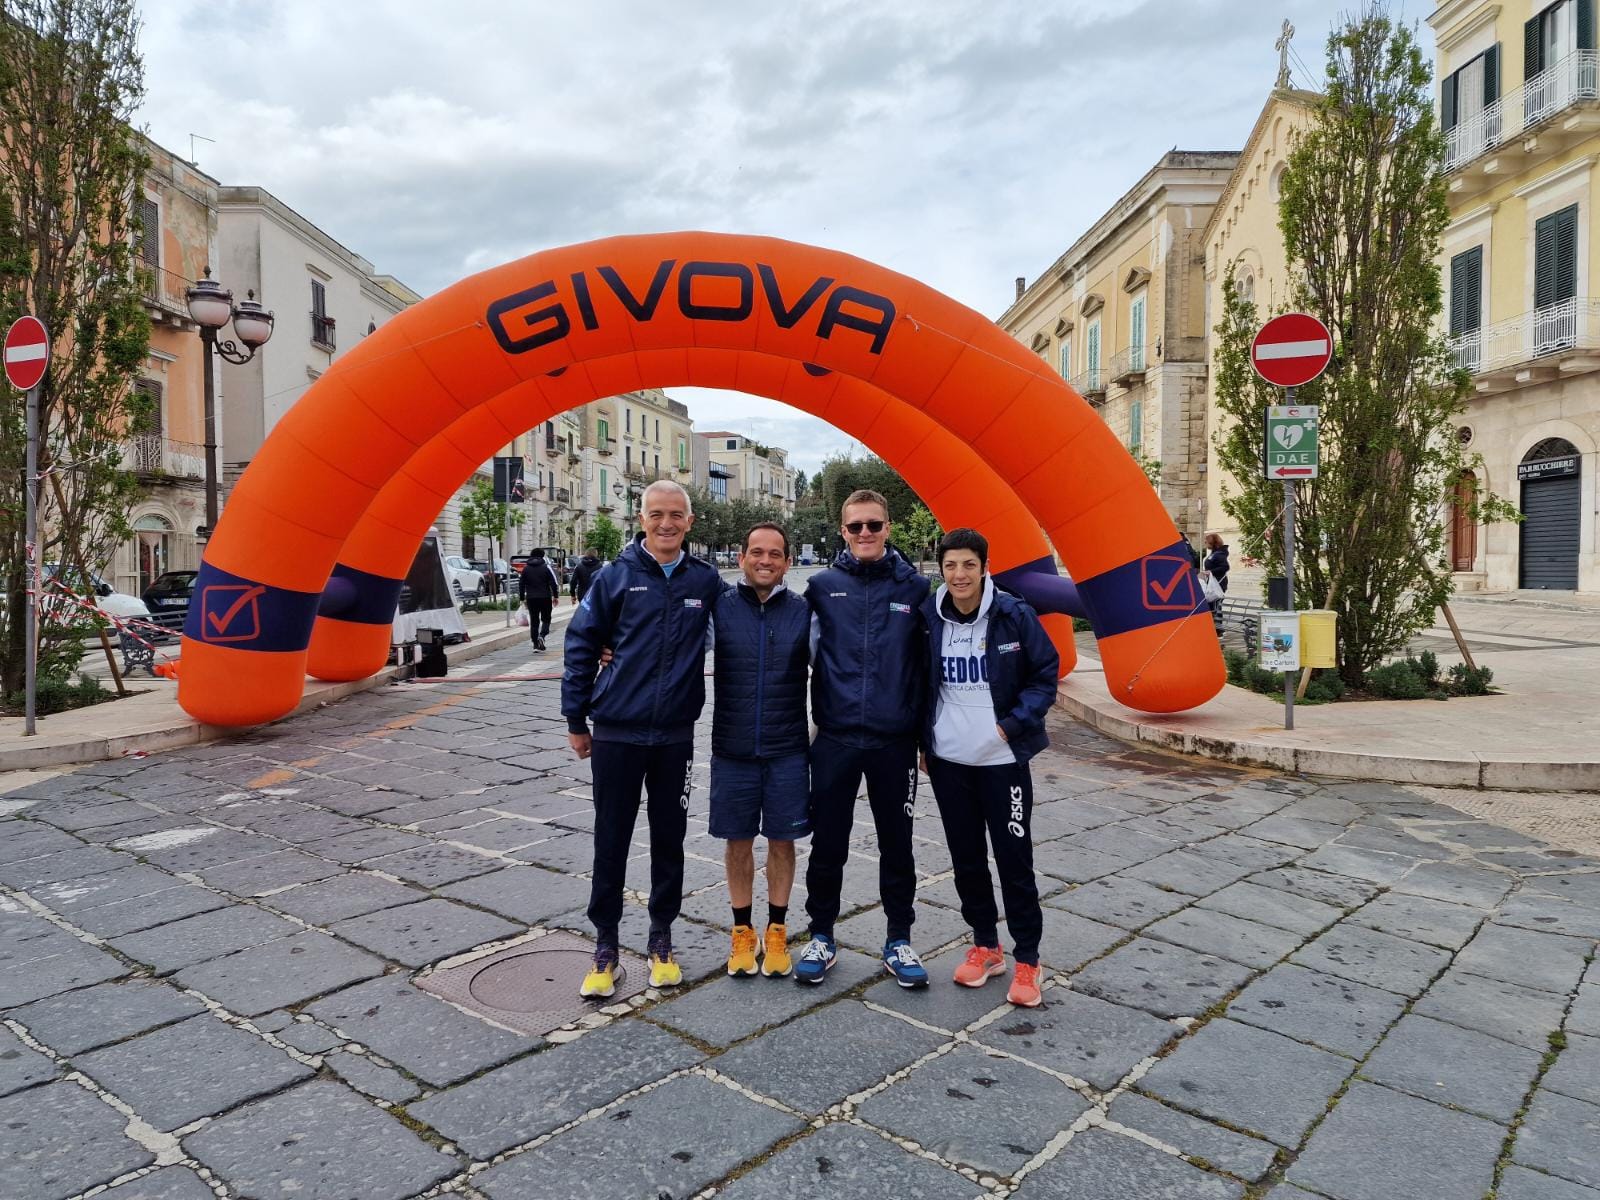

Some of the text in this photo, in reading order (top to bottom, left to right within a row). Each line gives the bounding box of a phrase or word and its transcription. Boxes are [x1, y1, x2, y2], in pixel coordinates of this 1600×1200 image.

[488, 259, 896, 355] GIVOVA
[1277, 453, 1309, 464] DAE
[1519, 459, 1574, 473] PARRUCCHIERE
